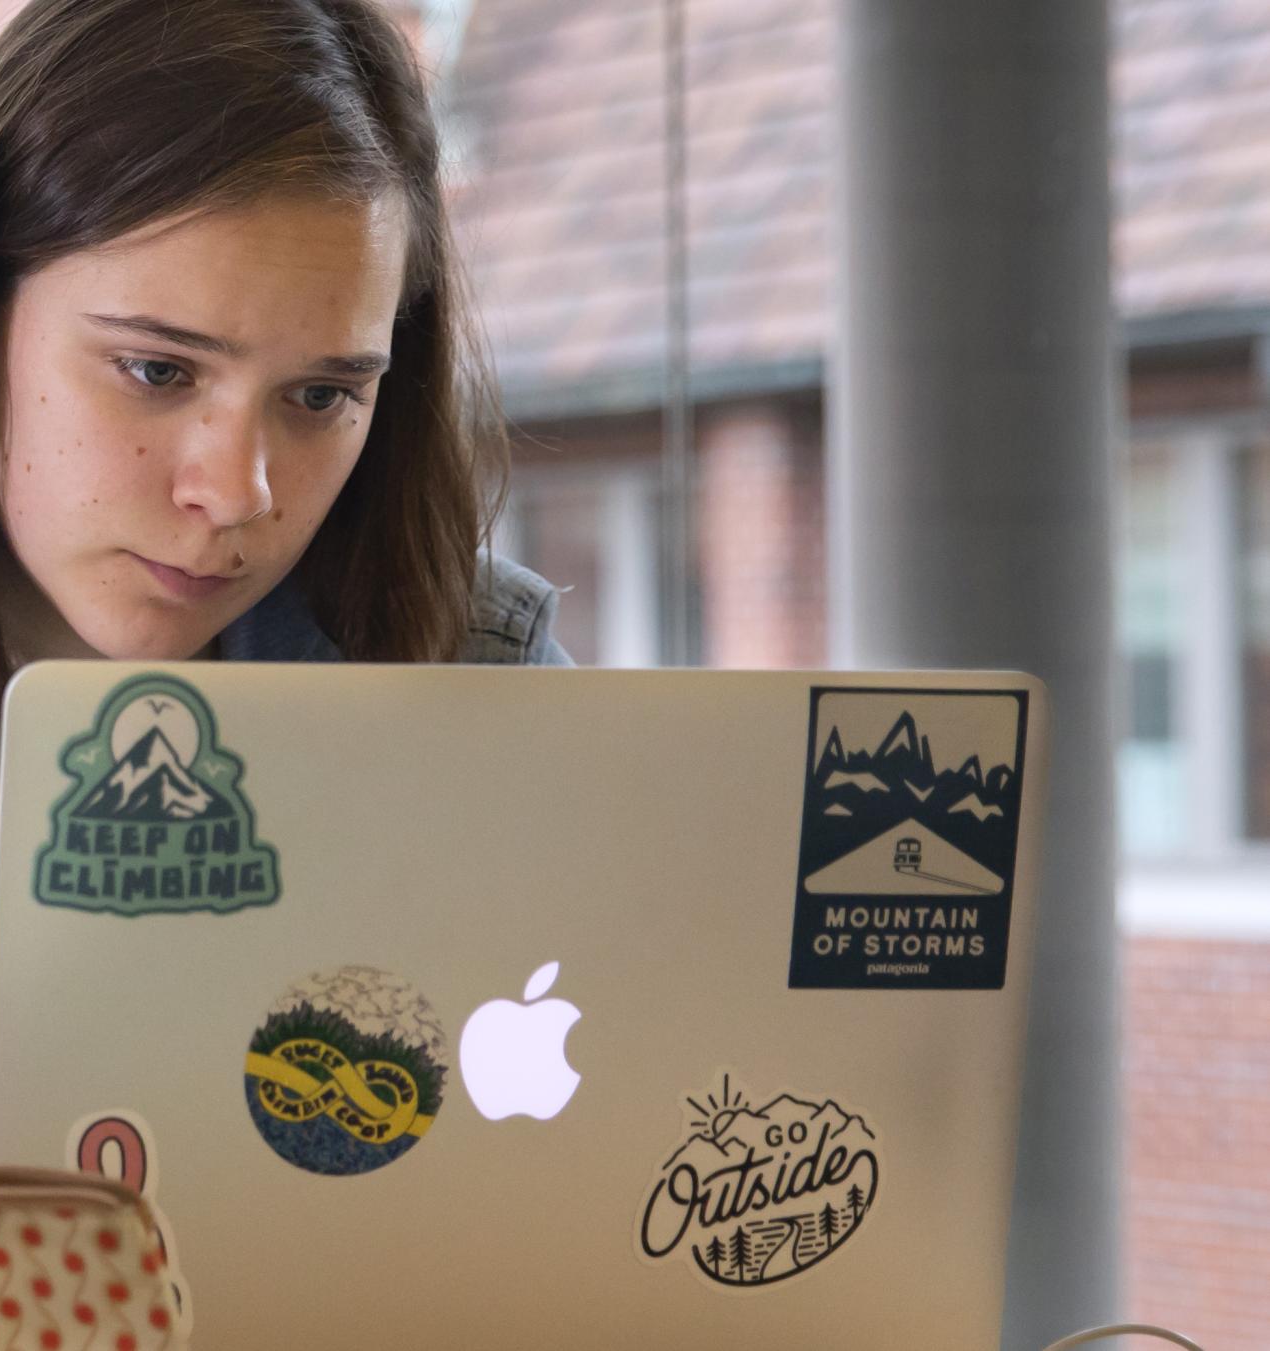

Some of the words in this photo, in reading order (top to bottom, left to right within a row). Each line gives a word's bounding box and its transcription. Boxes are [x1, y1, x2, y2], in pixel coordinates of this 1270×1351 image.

[66, 821, 168, 855] KEEP
[184, 820, 241, 855] ON
[48, 859, 266, 902] CLIMBING
[825, 907, 979, 929] MOUNTAIN
[813, 934, 852, 956] OF
[864, 935, 986, 956] STORMS
[866, 962, 930, 976] patagonia
[765, 1121, 808, 1147] GO
[641, 1122, 864, 1258] Outside
